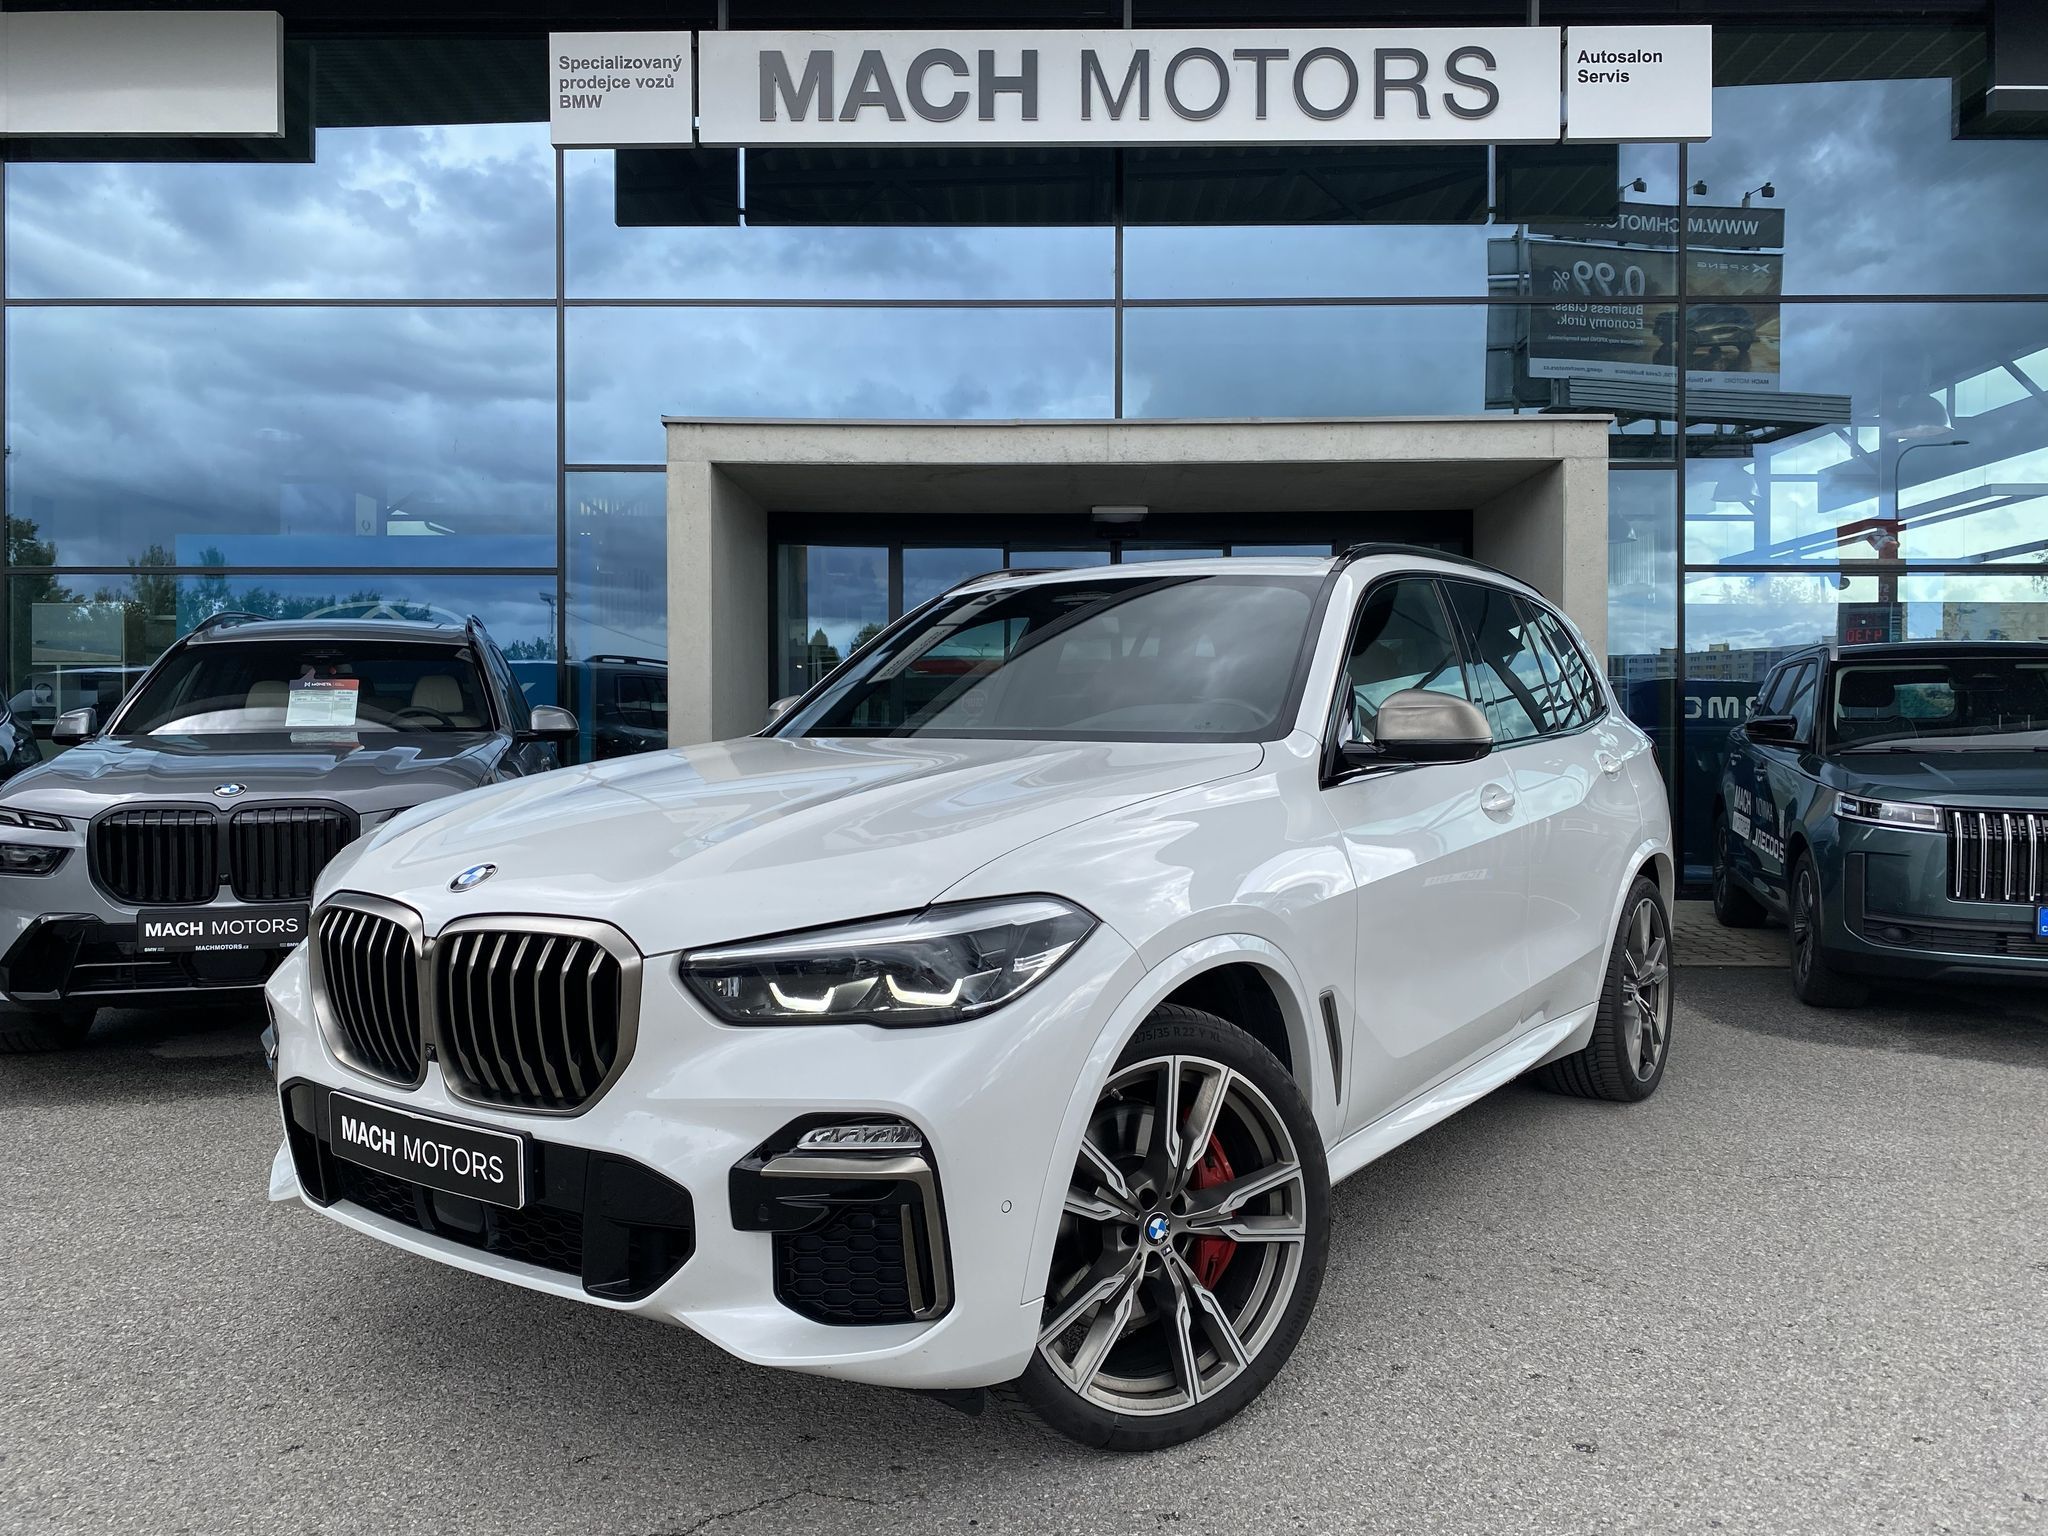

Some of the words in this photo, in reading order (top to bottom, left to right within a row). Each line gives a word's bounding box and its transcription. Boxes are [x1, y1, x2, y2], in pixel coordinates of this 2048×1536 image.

[558, 54, 682, 72] Specializovaný
[1577, 49, 1663, 65] Autosalon
[558, 73, 631, 92] prodejce
[636, 72, 675, 90] vozů
[759, 48, 1038, 122] MACH
[1080, 46, 1500, 121] MOTORS
[1577, 69, 1631, 84] Servis
[558, 94, 603, 109] BMW
[1734, 784, 1752, 816] MACH
[145, 921, 203, 937] MACH
[212, 918, 299, 935] MOTORS
[341, 1115, 396, 1156] MACH
[403, 1134, 504, 1184] MOTORS
